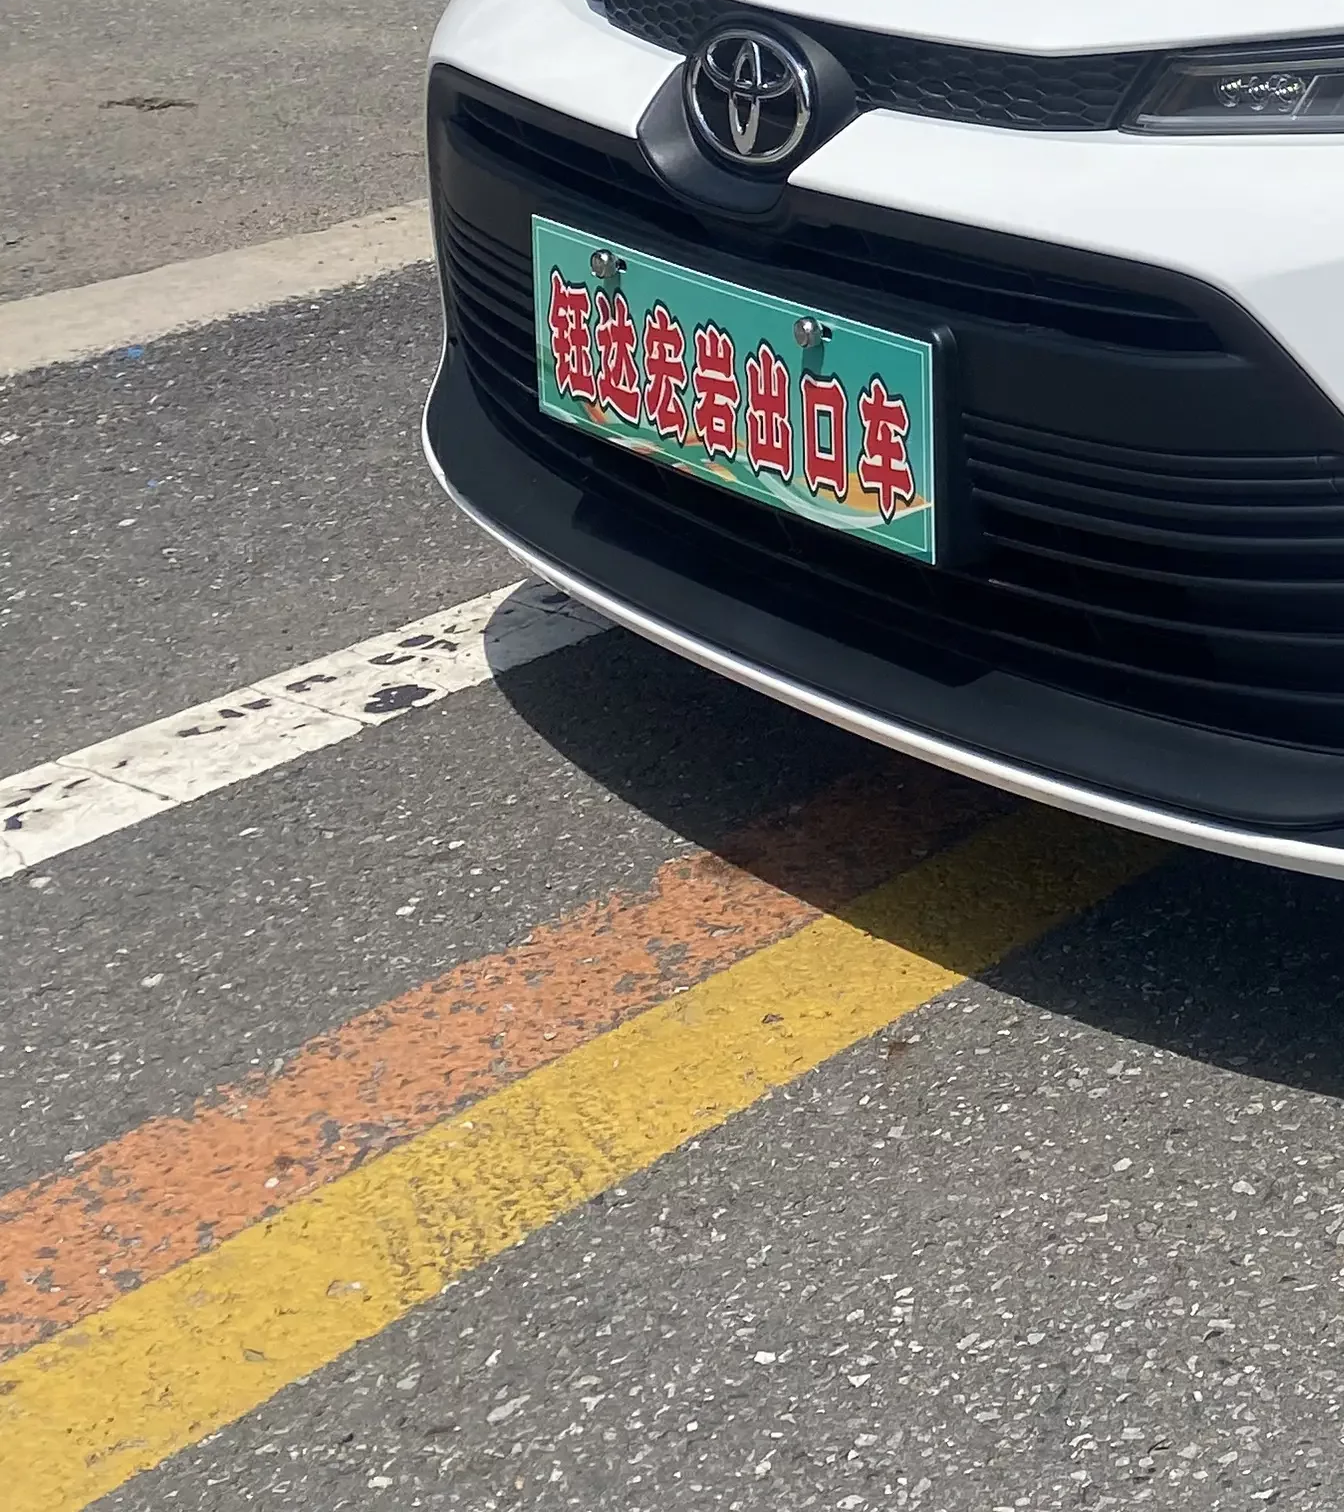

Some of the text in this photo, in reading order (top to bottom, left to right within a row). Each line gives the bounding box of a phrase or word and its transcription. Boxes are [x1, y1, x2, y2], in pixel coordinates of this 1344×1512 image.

[548, 266, 916, 523] 钰达宏岩出口车
